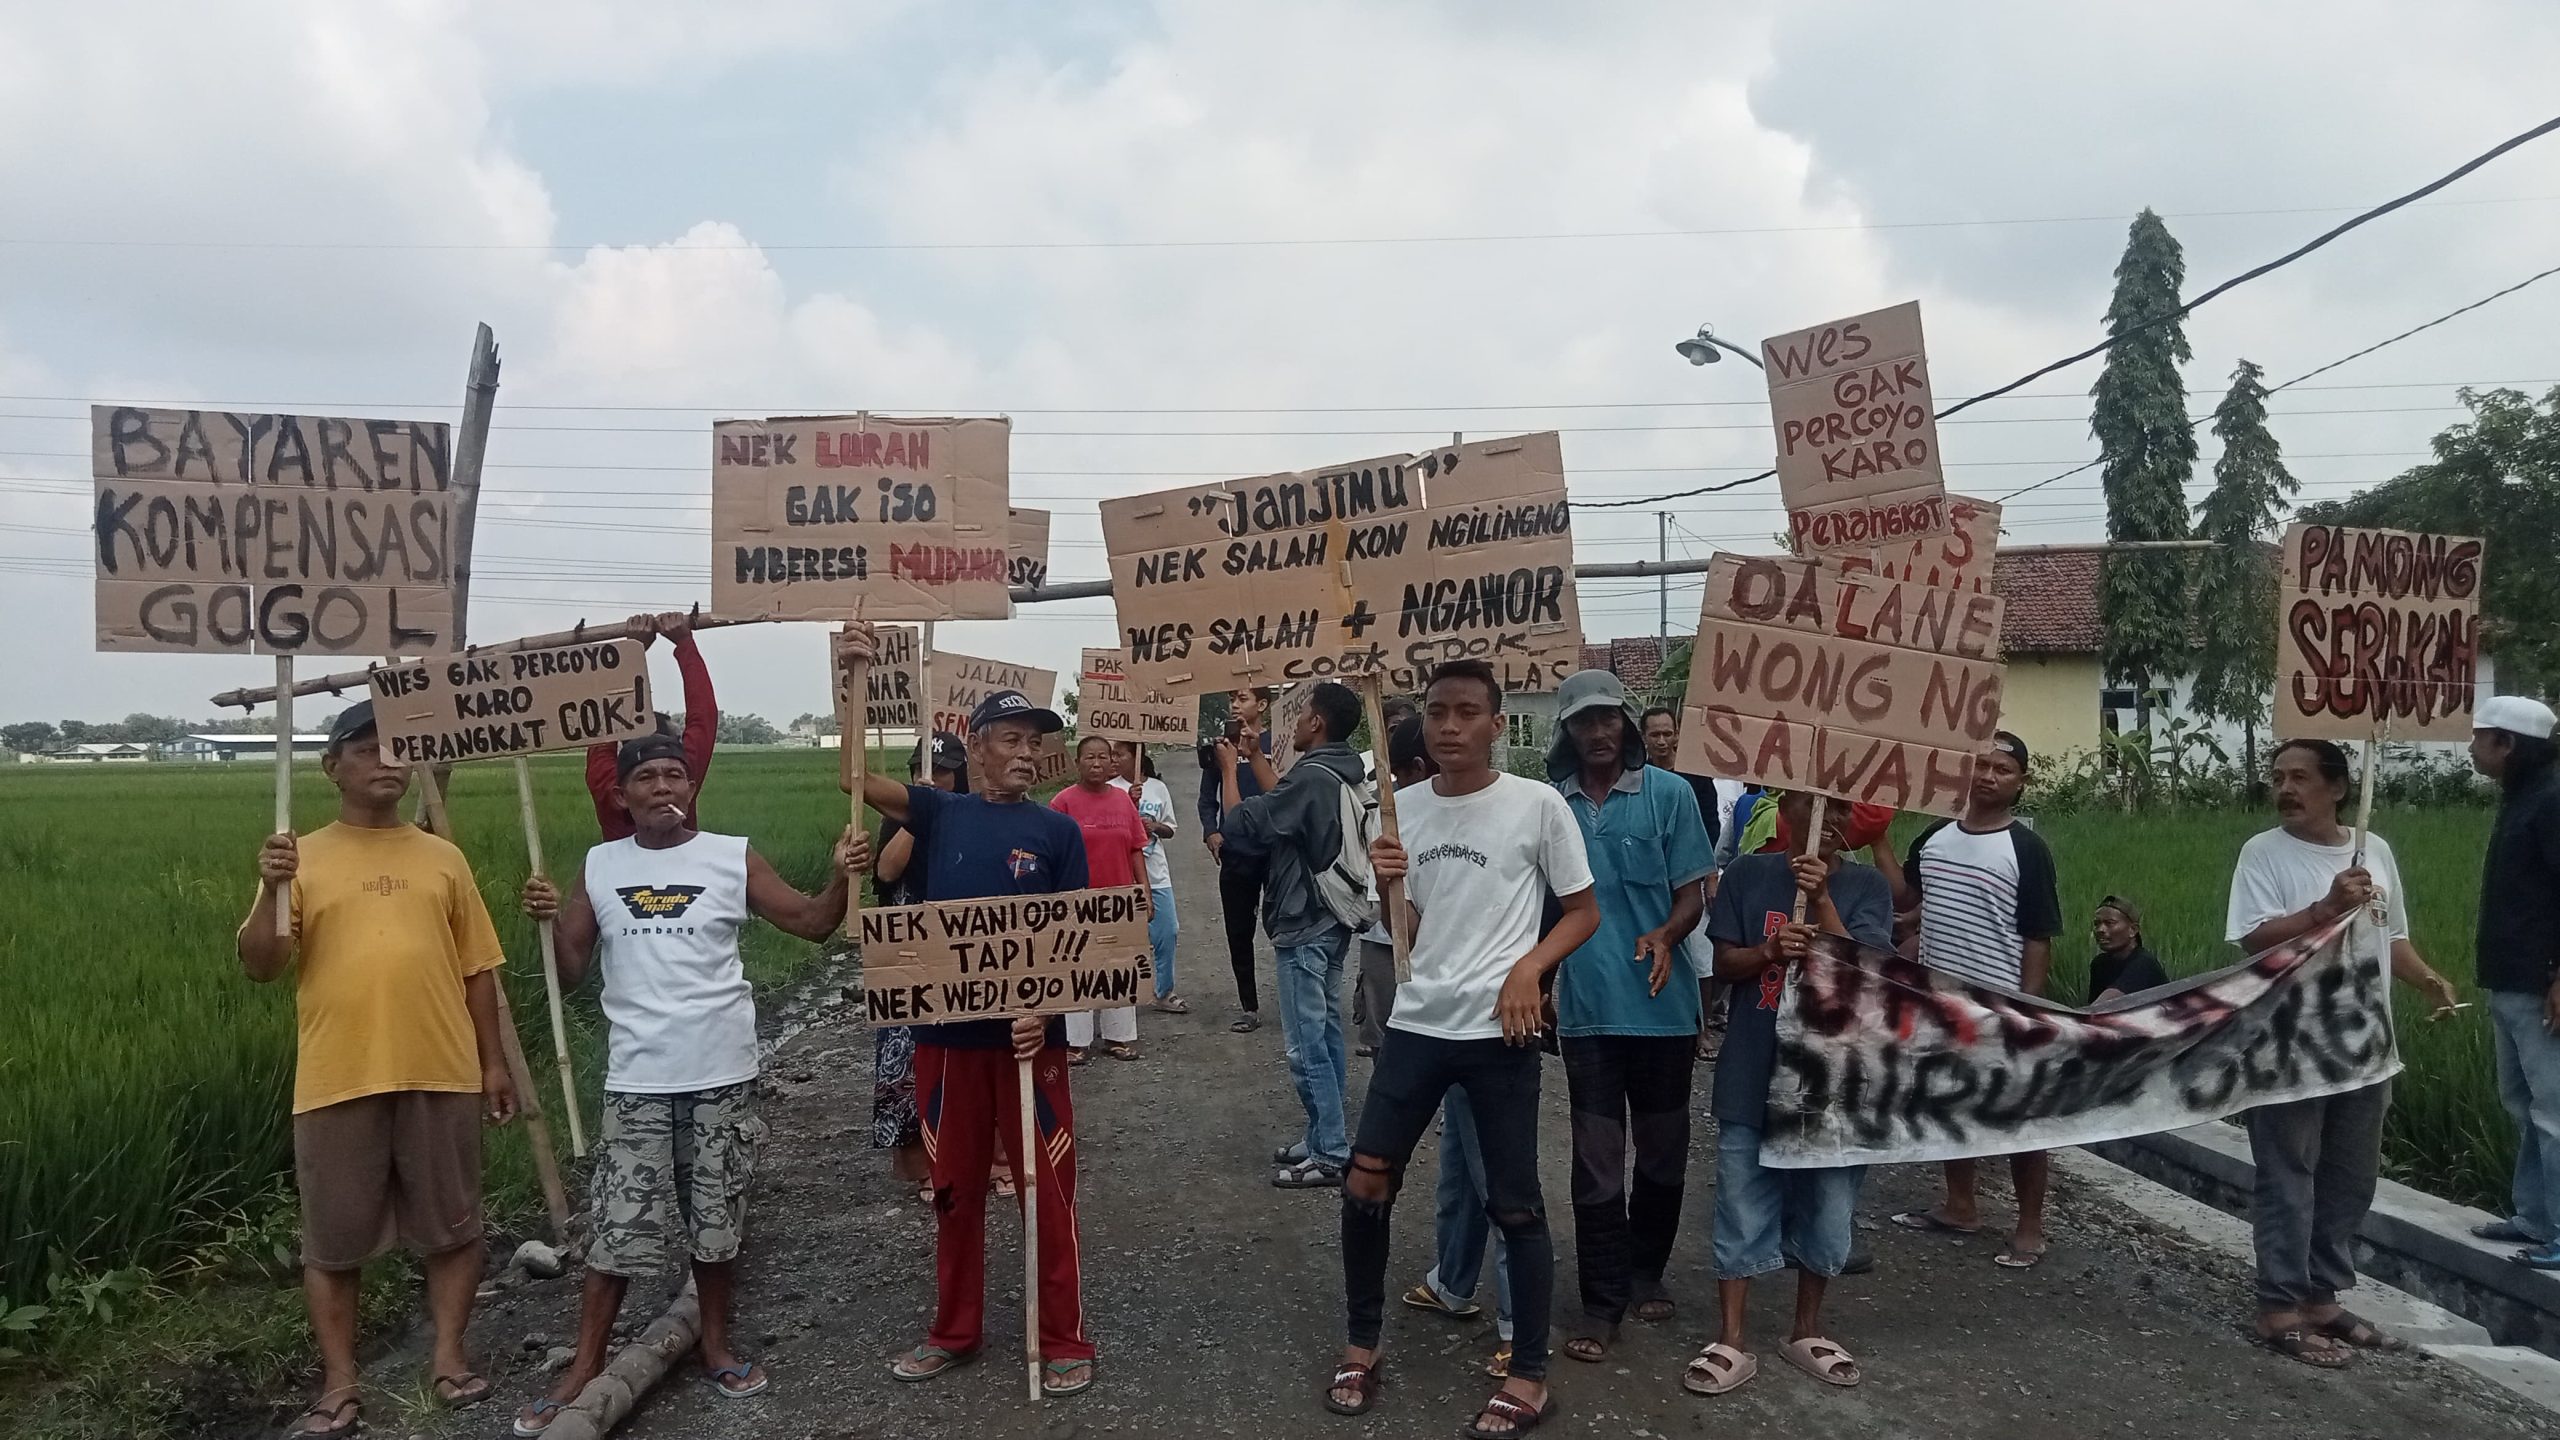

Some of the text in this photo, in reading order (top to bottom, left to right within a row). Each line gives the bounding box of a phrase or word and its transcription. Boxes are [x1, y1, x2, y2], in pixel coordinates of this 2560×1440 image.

[1833, 359, 1924, 410] GAK
[109, 405, 451, 495] BAYAREN
[720, 429, 931, 471] NEK LURAH
[1820, 438, 1928, 484] KARO
[785, 484, 863, 526] GAK
[96, 486, 450, 582] KOMPENSASI
[1134, 546, 1208, 588] NEK
[1221, 531, 1328, 577] SALAH
[1344, 520, 1409, 562] KON
[2299, 525, 2483, 602] PAMONG
[139, 583, 438, 650] GOGOL
[1127, 564, 1565, 665] WES SALAH + NGAWOR
[373, 643, 621, 699] WES GAK PERCOYO
[956, 663, 1028, 690] JALAN
[1094, 658, 1124, 674] PAK
[1282, 642, 1389, 679] COOK
[454, 685, 534, 721] KARO
[1711, 631, 2003, 741] WONG NG
[391, 674, 646, 762] PERANGKAT COK!
[1090, 710, 1191, 732] GOGOL TUNGGUL
[1703, 704, 1977, 813] SAWAH
[622, 925, 695, 936] Jombang
[861, 910, 929, 945] NEK
[938, 902, 1018, 938] WANI
[1023, 899, 1069, 933] OJO
[949, 929, 1091, 974] TAPI !!!
[867, 983, 936, 1022] NEK
[1016, 976, 1064, 1009] OJO
